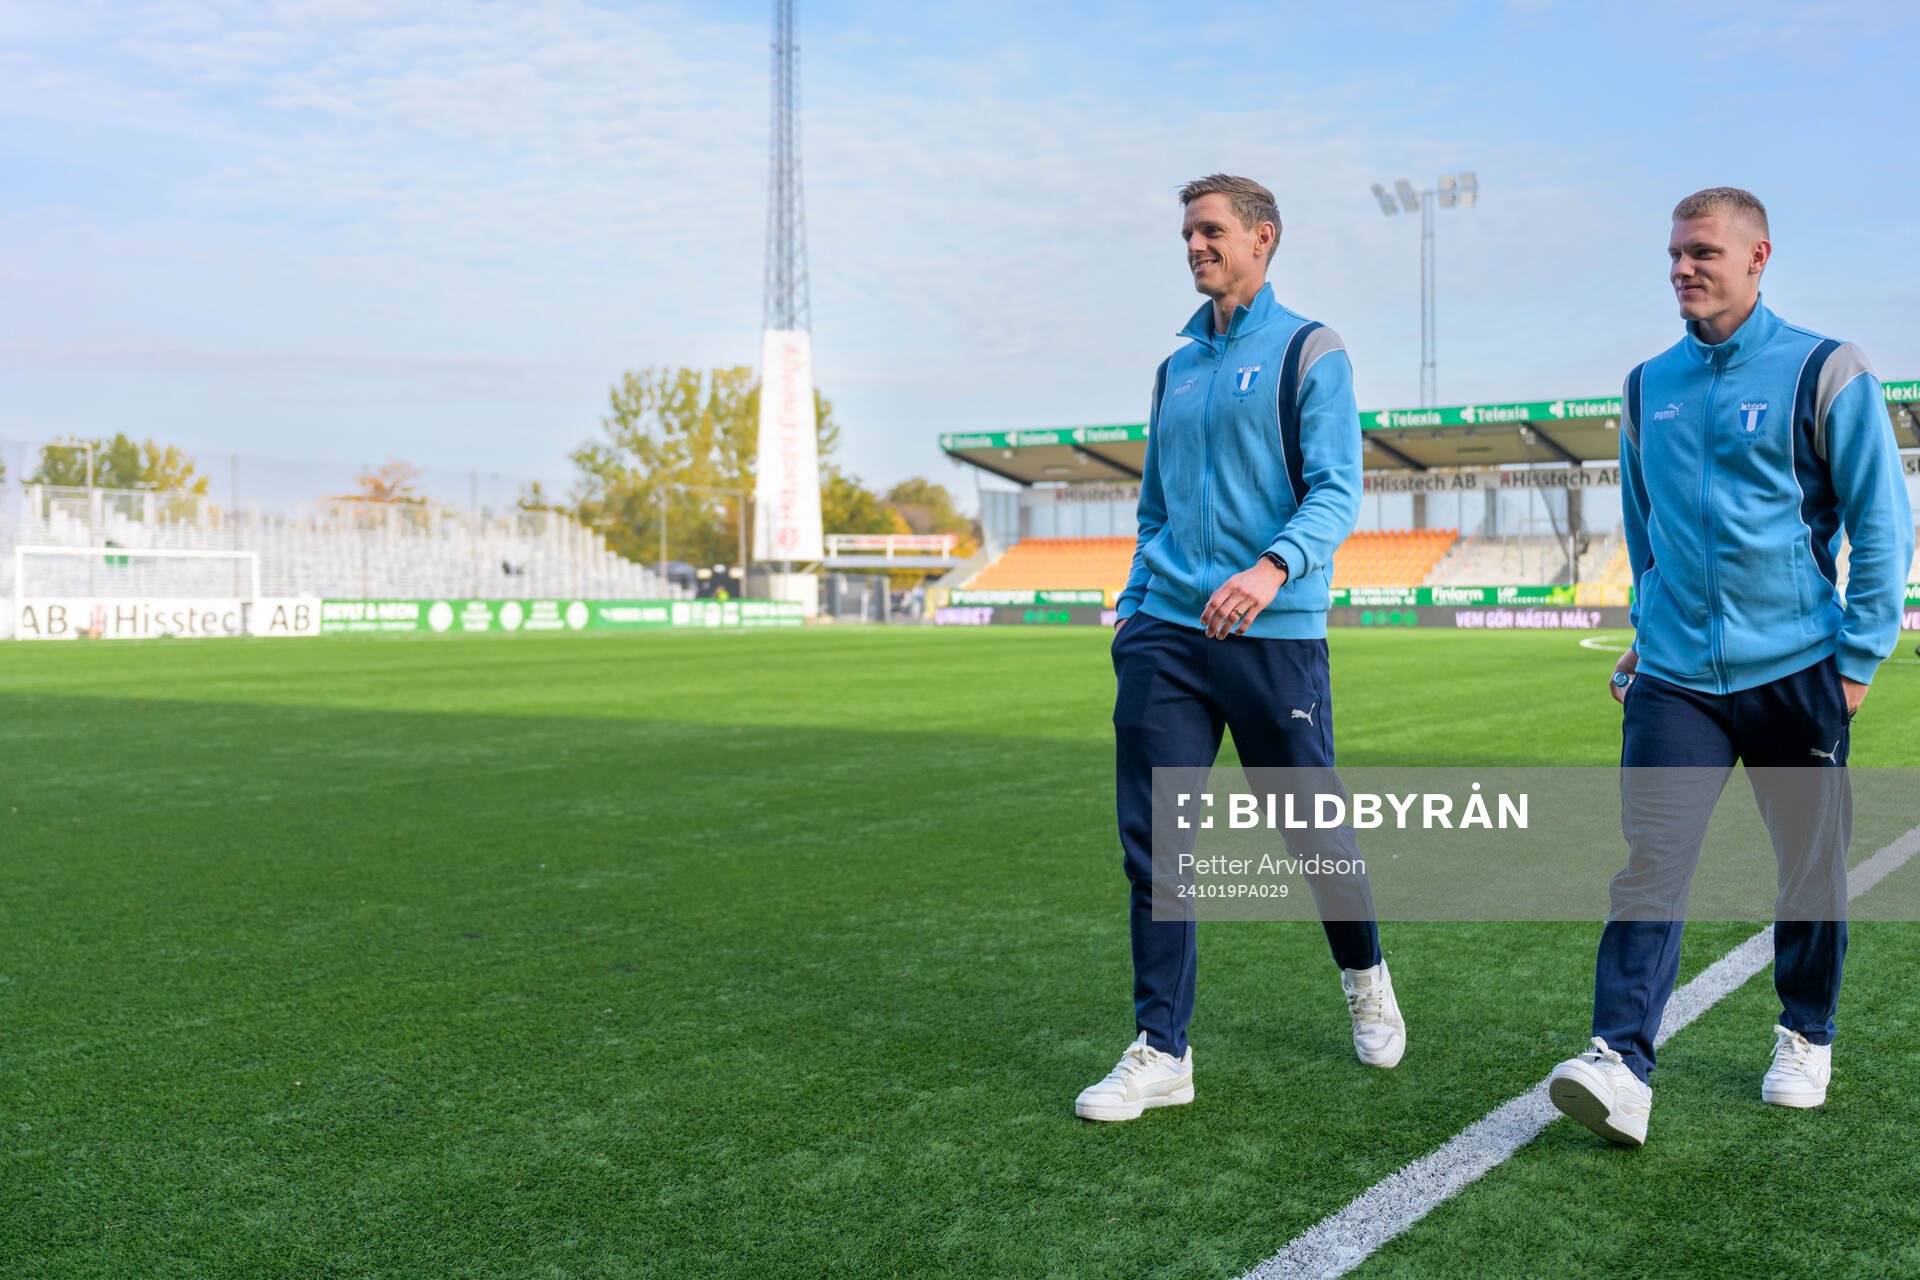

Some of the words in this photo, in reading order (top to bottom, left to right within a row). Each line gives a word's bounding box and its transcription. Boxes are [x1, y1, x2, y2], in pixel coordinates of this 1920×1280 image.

[1475, 405, 1529, 422] Telexia
[1566, 400, 1621, 417] Telexia
[1373, 472, 1445, 491] Hisstech
[1452, 473, 1476, 490] AB
[1512, 468, 1591, 487] Hisstech
[22, 604, 68, 635] AB
[269, 604, 311, 632] AB
[1455, 611, 1485, 629] VEM
[1486, 608, 1514, 629] GÖR
[1515, 608, 1559, 629] NÄSTA
